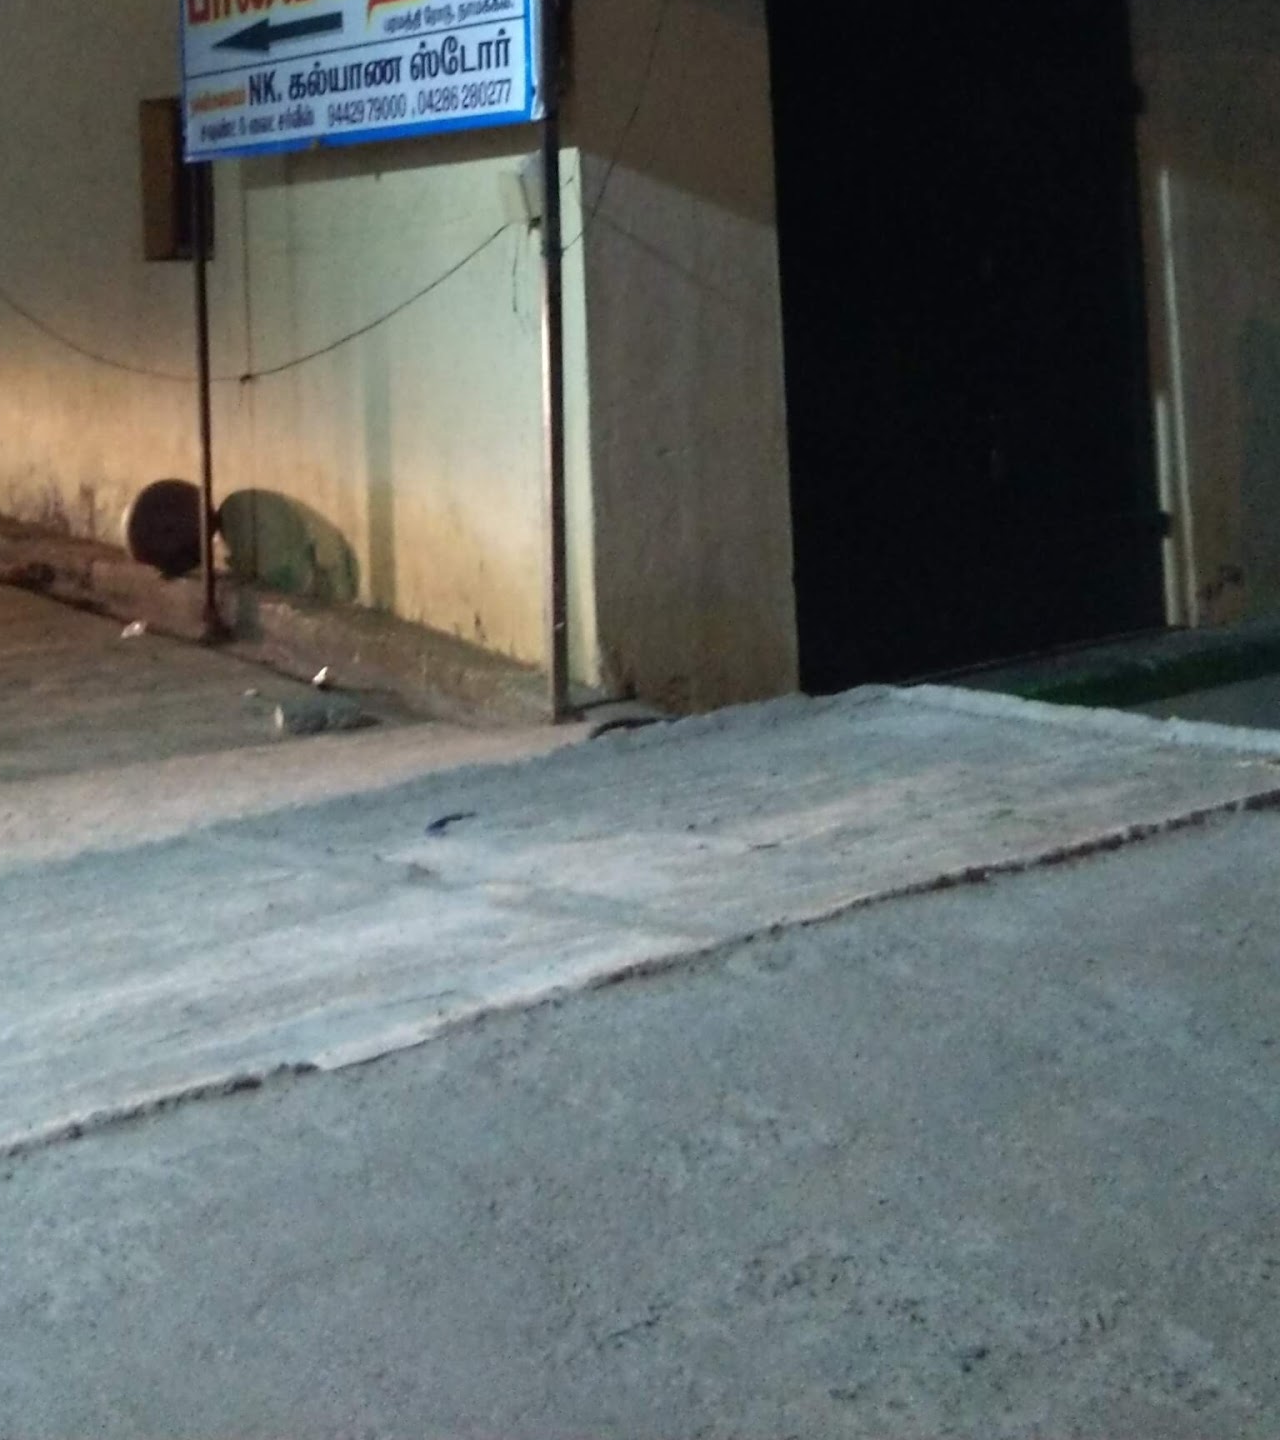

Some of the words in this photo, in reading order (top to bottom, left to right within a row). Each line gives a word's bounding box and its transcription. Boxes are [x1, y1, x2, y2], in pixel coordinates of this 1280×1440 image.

[248, 70, 282, 106] NK.
[288, 56, 403, 100] கல்யாண
[409, 27, 512, 81] ஸ்டோர்
[461, 78, 512, 109] 280277
